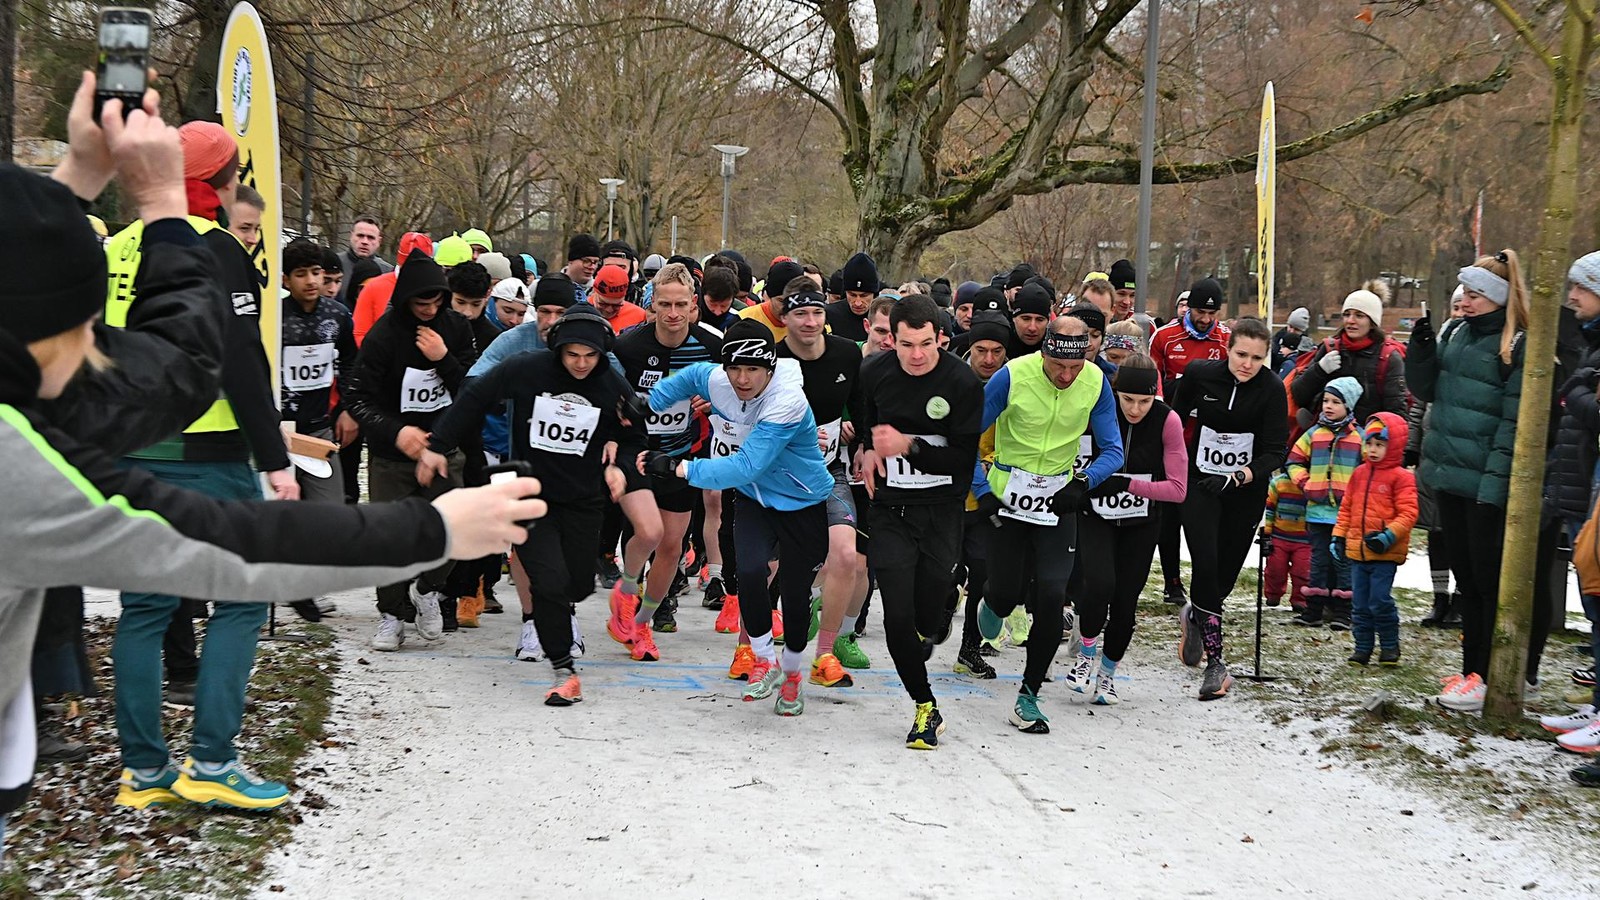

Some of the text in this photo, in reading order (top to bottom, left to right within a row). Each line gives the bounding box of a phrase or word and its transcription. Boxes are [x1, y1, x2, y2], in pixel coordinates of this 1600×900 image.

[1208, 348, 1220, 360] 23
[289, 362, 329, 381] 1057
[644, 371, 660, 382] ing
[646, 412, 686, 426] 009
[538, 420, 590, 444] 1054
[713, 437, 740, 457] 105
[1203, 446, 1249, 467] 1003
[1009, 491, 1055, 514] 1029
[1098, 494, 1145, 509] 1068
